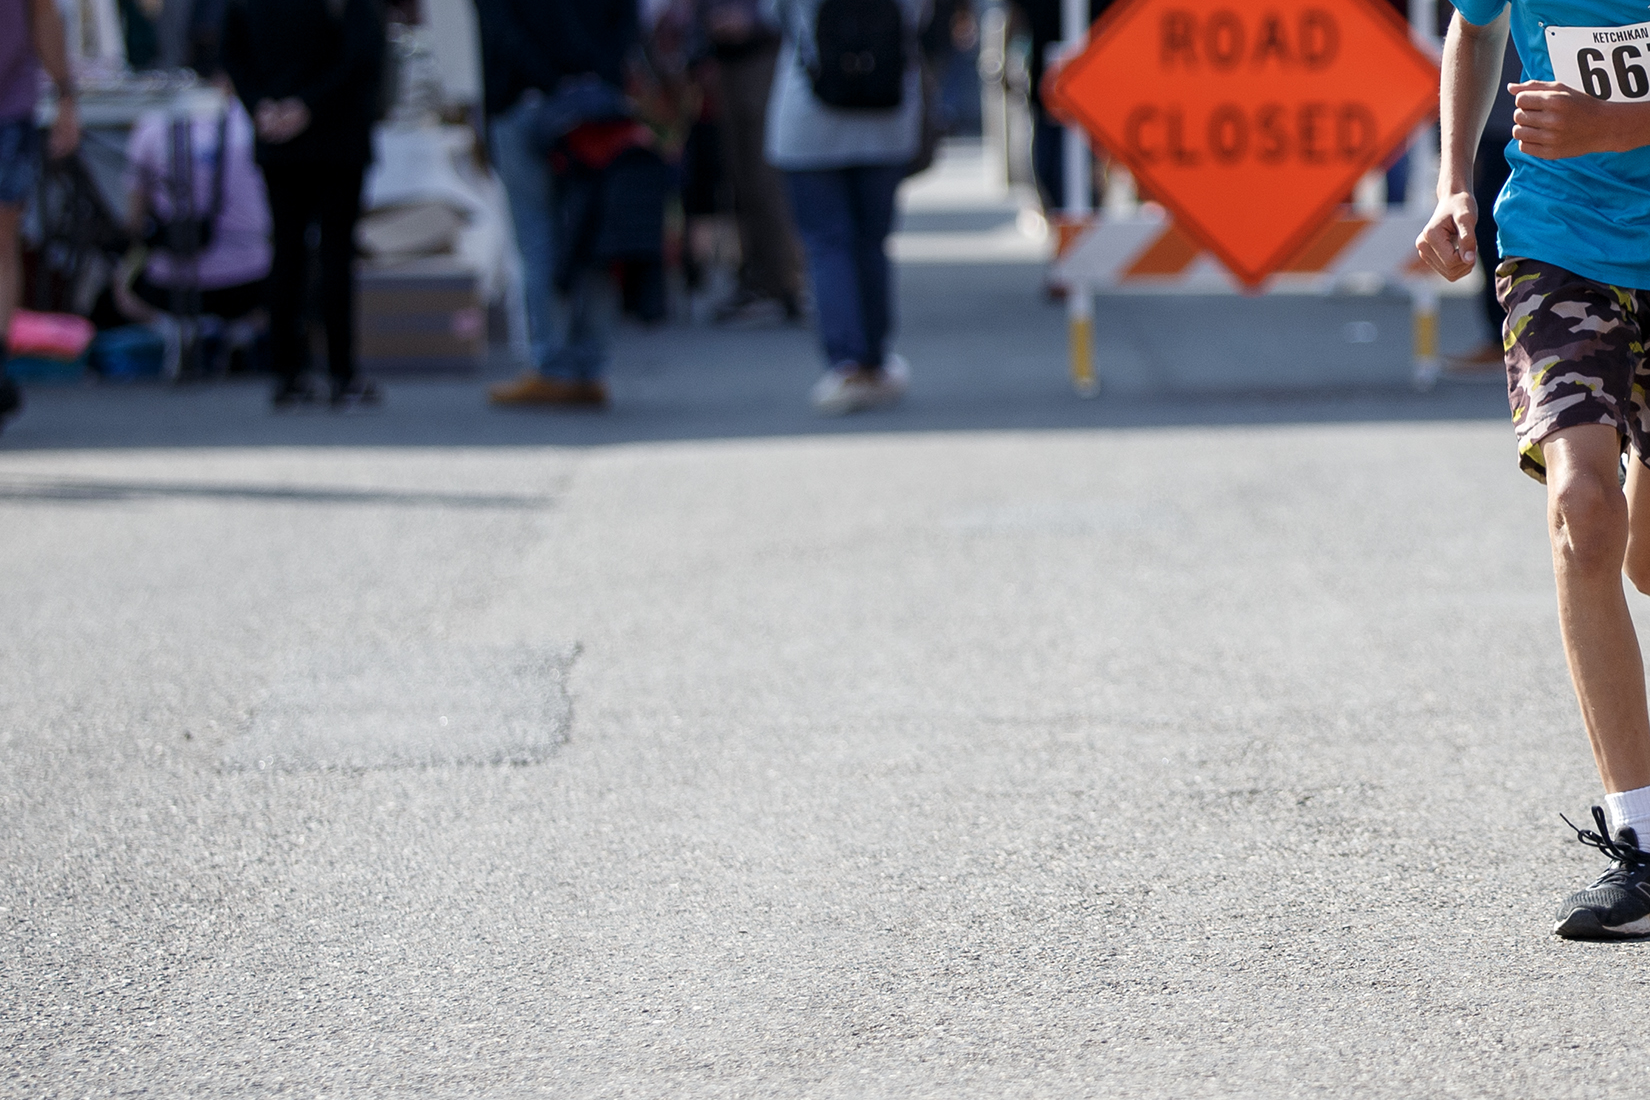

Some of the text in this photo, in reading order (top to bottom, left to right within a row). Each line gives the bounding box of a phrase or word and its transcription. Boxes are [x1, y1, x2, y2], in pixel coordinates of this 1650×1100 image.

[1157, 9, 1341, 74] ROAD
[1592, 27, 1649, 43] KETCHIKAN
[1124, 101, 1378, 167] CLOSED
